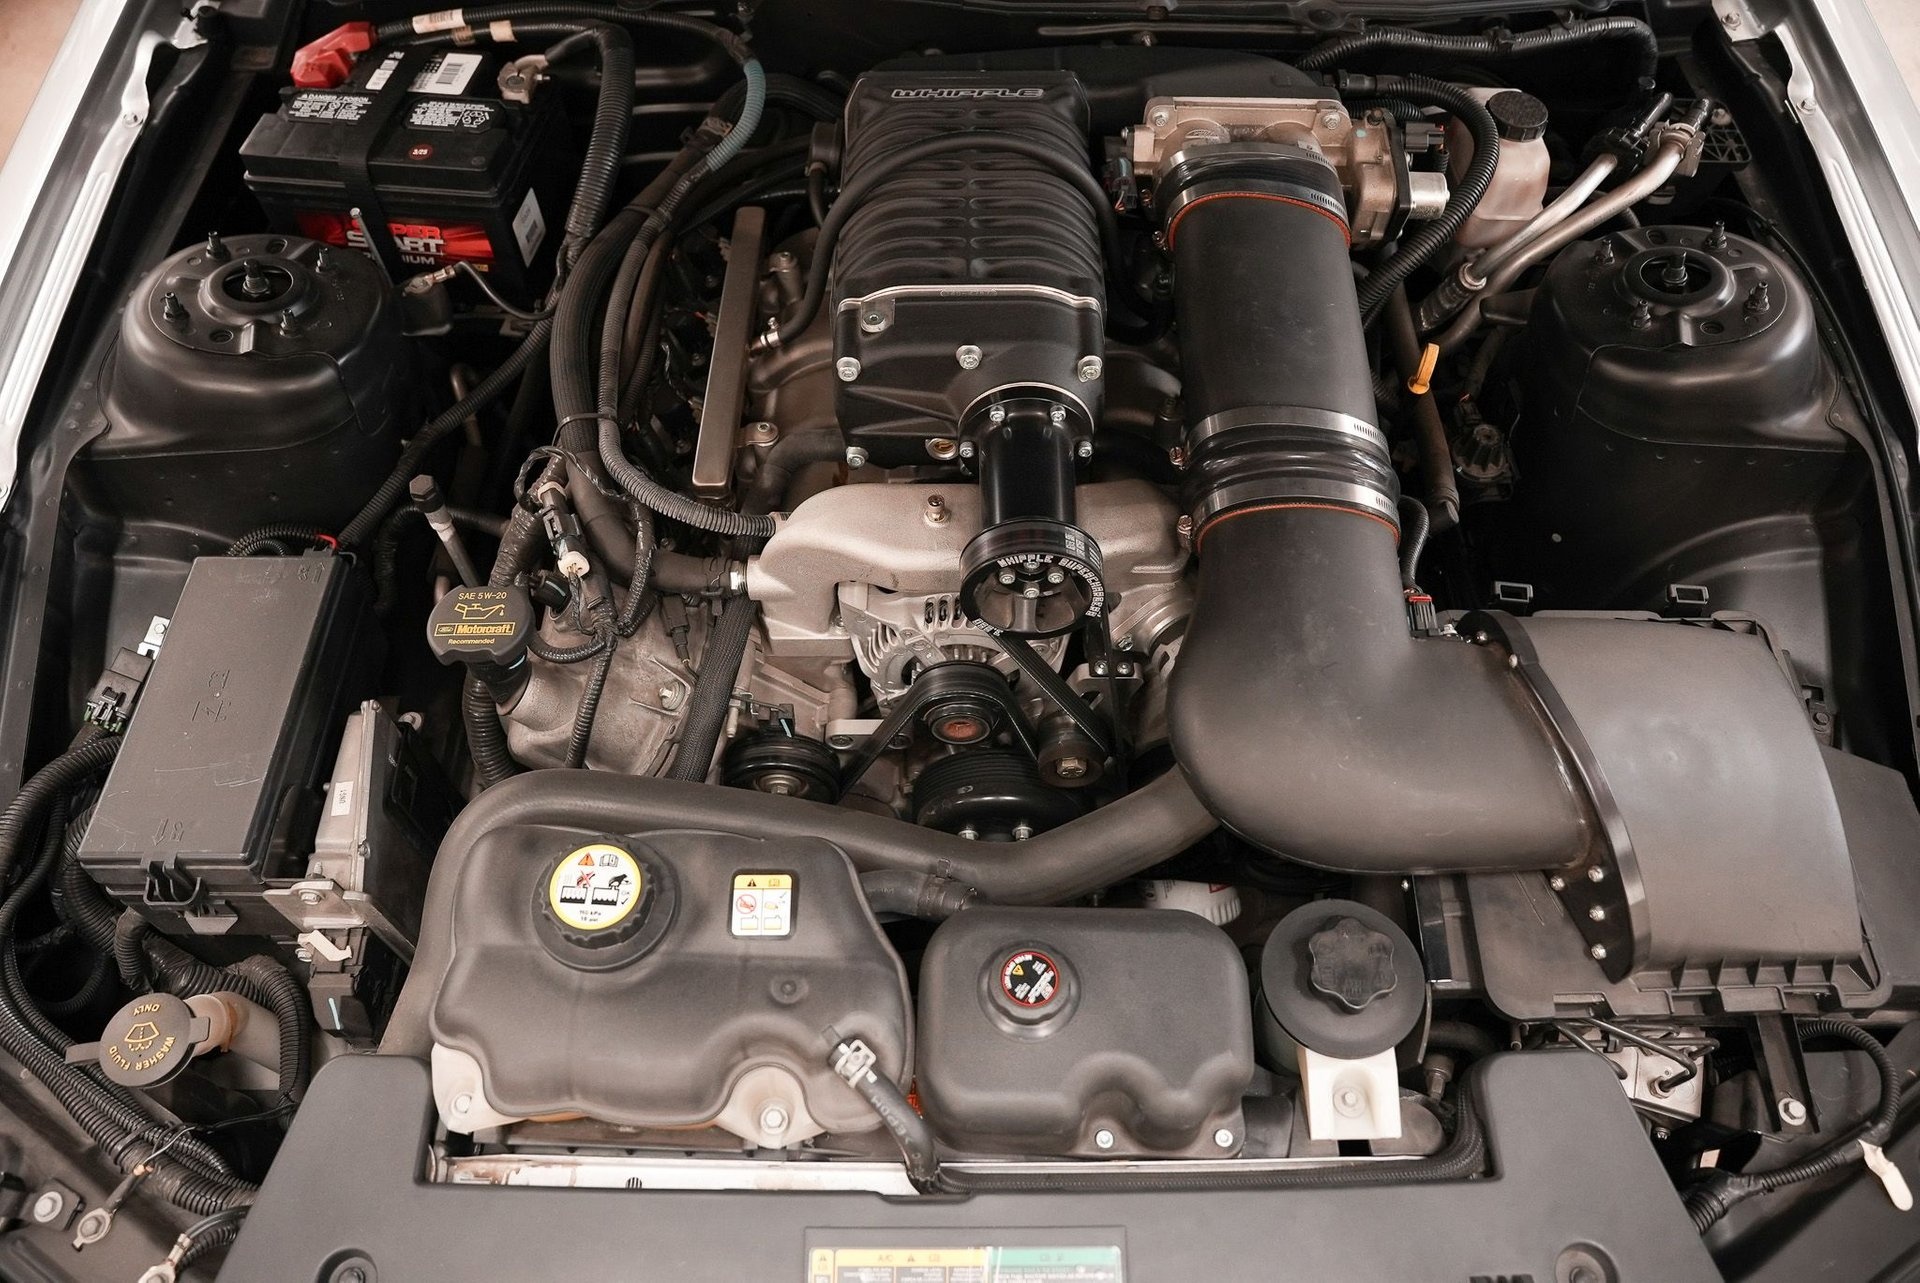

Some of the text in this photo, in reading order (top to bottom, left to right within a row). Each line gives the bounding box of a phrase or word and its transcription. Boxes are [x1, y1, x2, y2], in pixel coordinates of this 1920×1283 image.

[891, 88, 1044, 98] WHIPPLE
[997, 554, 1054, 568] WHIPPLE
[458, 592, 476, 600] SAE
[457, 624, 512, 634] Motorcraft
[133, 1003, 160, 1016] ONLY
[109, 1036, 176, 1071] WASHER FLUID
